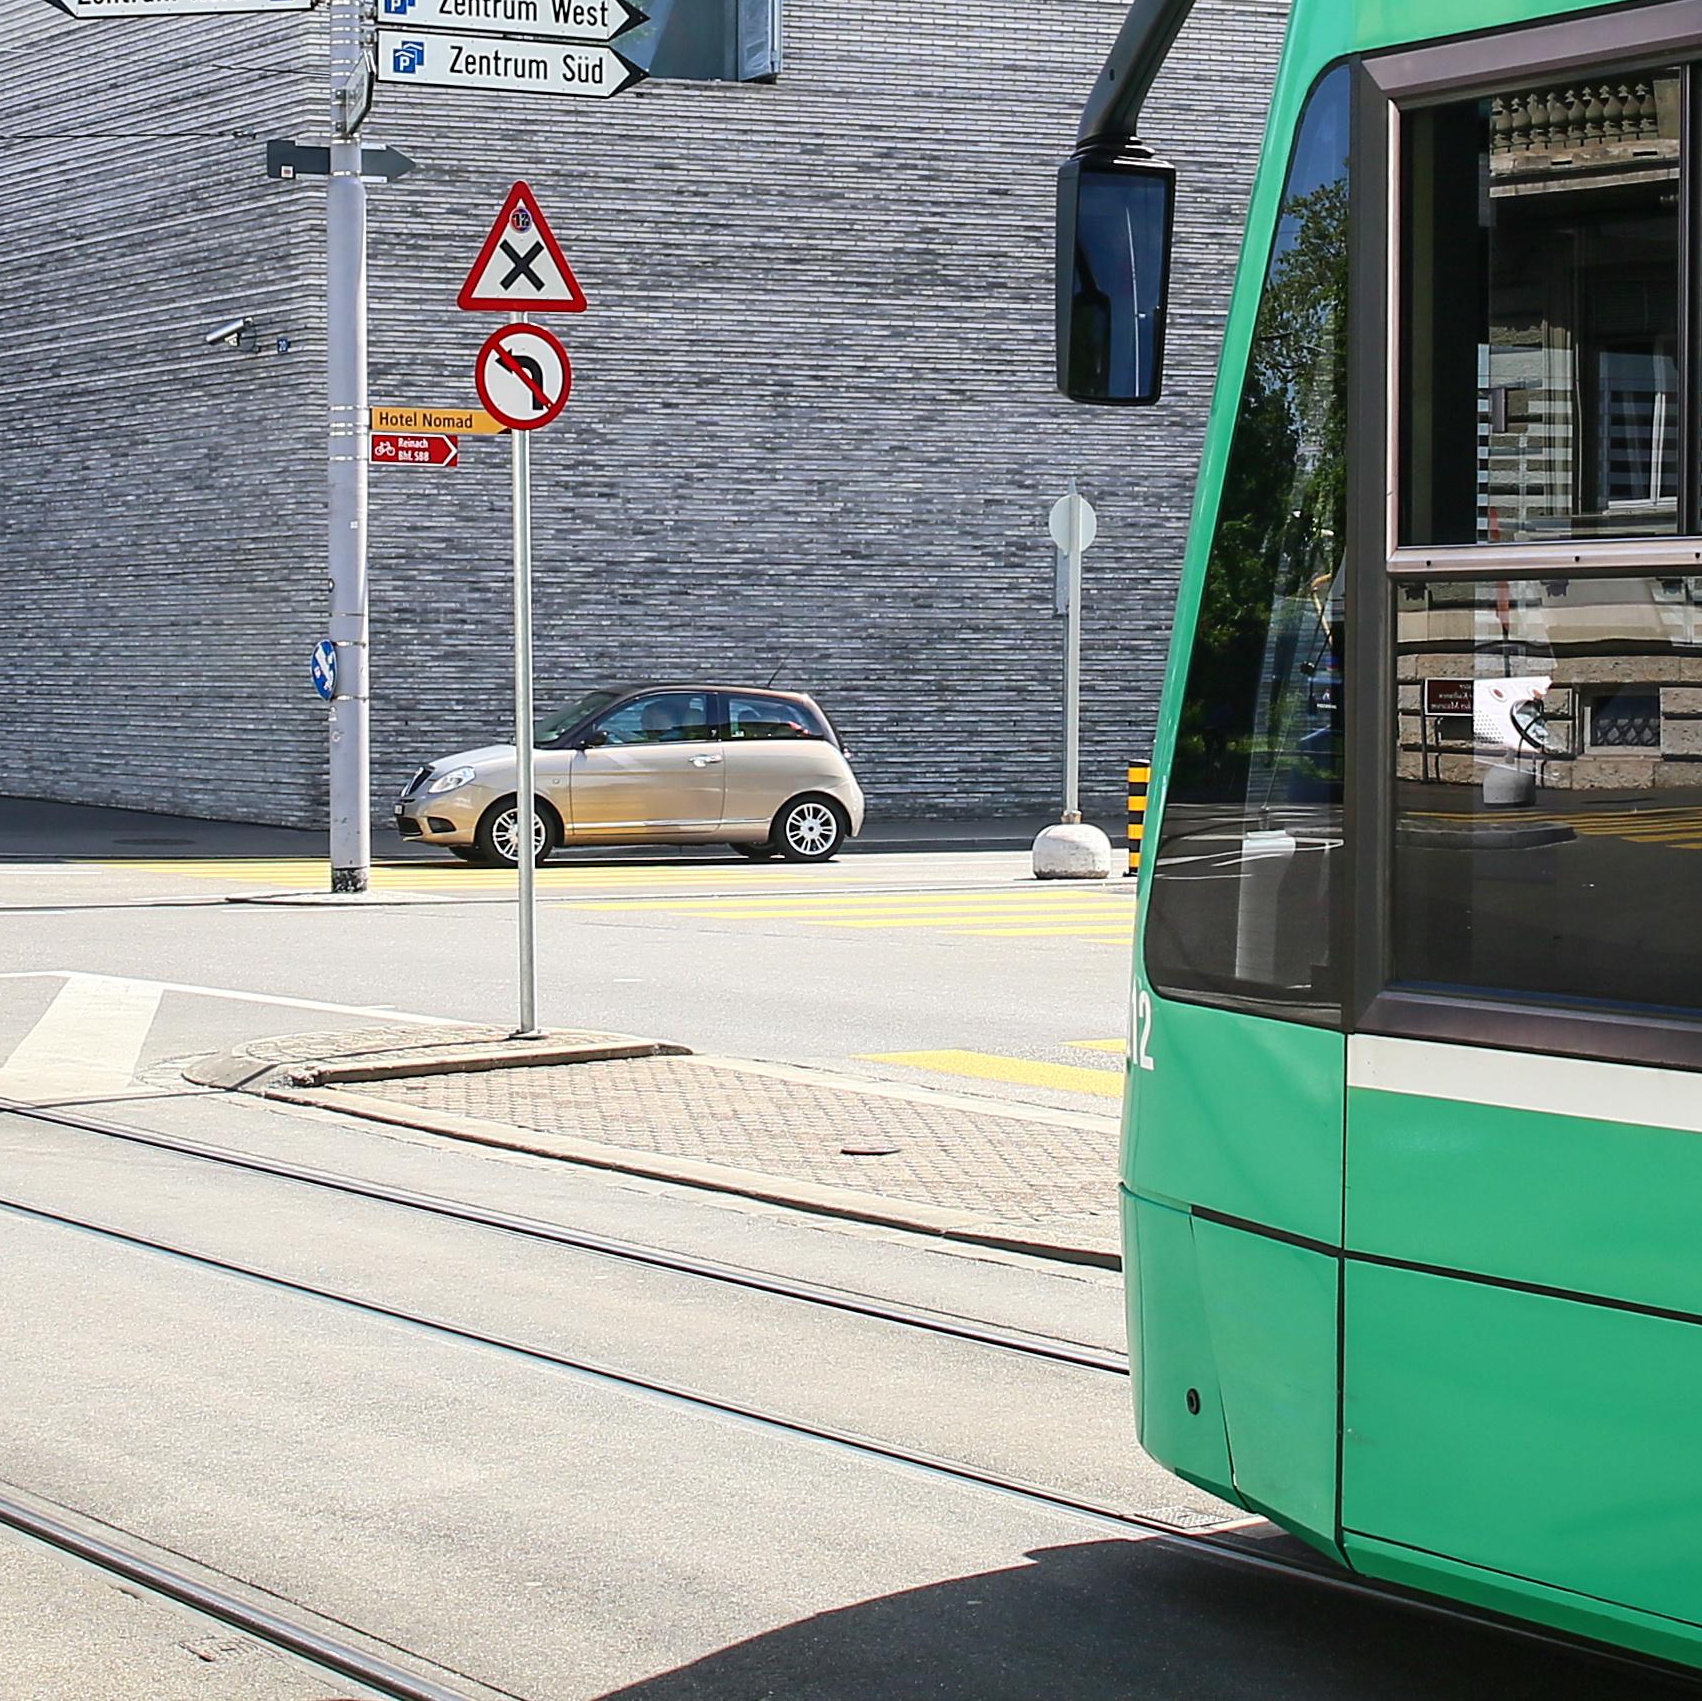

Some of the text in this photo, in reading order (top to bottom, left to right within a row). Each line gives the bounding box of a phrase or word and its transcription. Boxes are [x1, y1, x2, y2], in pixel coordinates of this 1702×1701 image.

[449, 45, 548, 80] Zentrum
[562, 54, 604, 84] Süd
[379, 411, 473, 429] Hotel Nomad
[397, 437, 429, 448] Reinach
[414, 450, 430, 462] SBB
